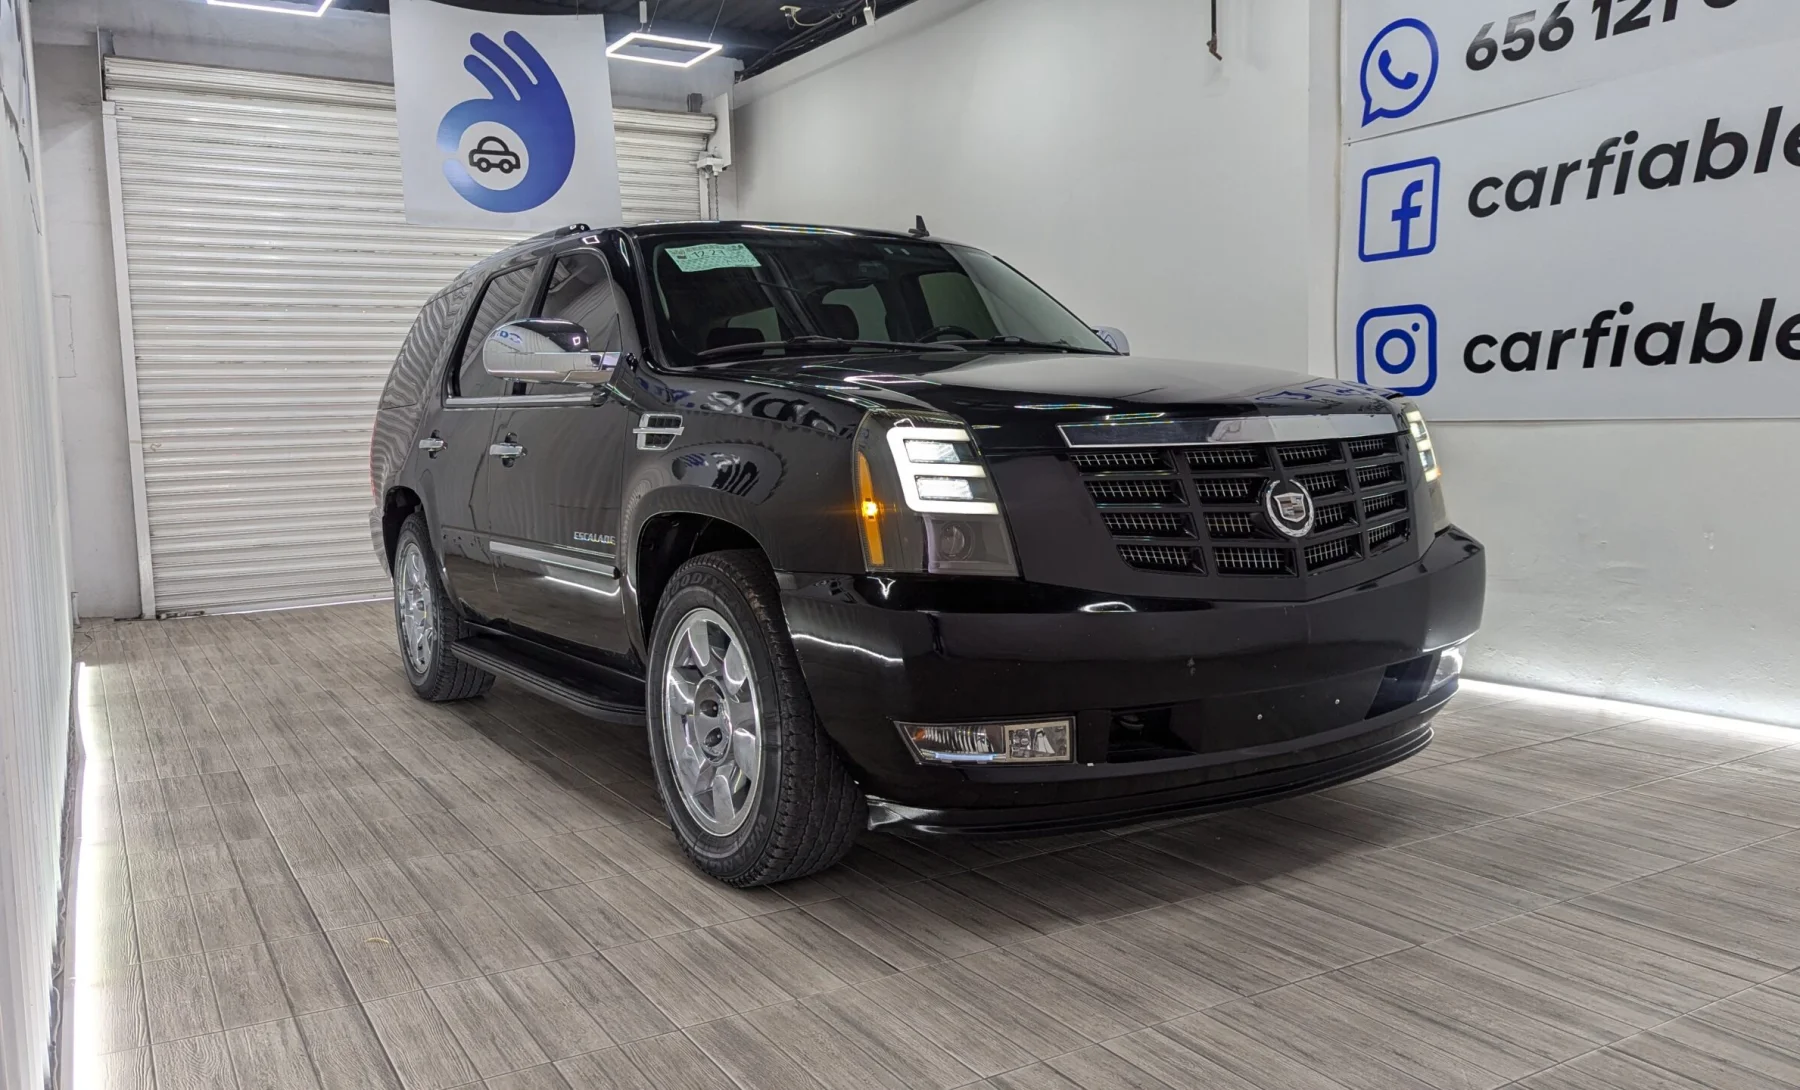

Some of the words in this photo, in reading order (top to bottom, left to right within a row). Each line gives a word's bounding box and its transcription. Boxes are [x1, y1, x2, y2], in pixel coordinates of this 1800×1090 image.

[1465, 0, 1574, 71] 656
[1463, 297, 1800, 375] carfiable
[573, 531, 617, 546] ESCALADE
